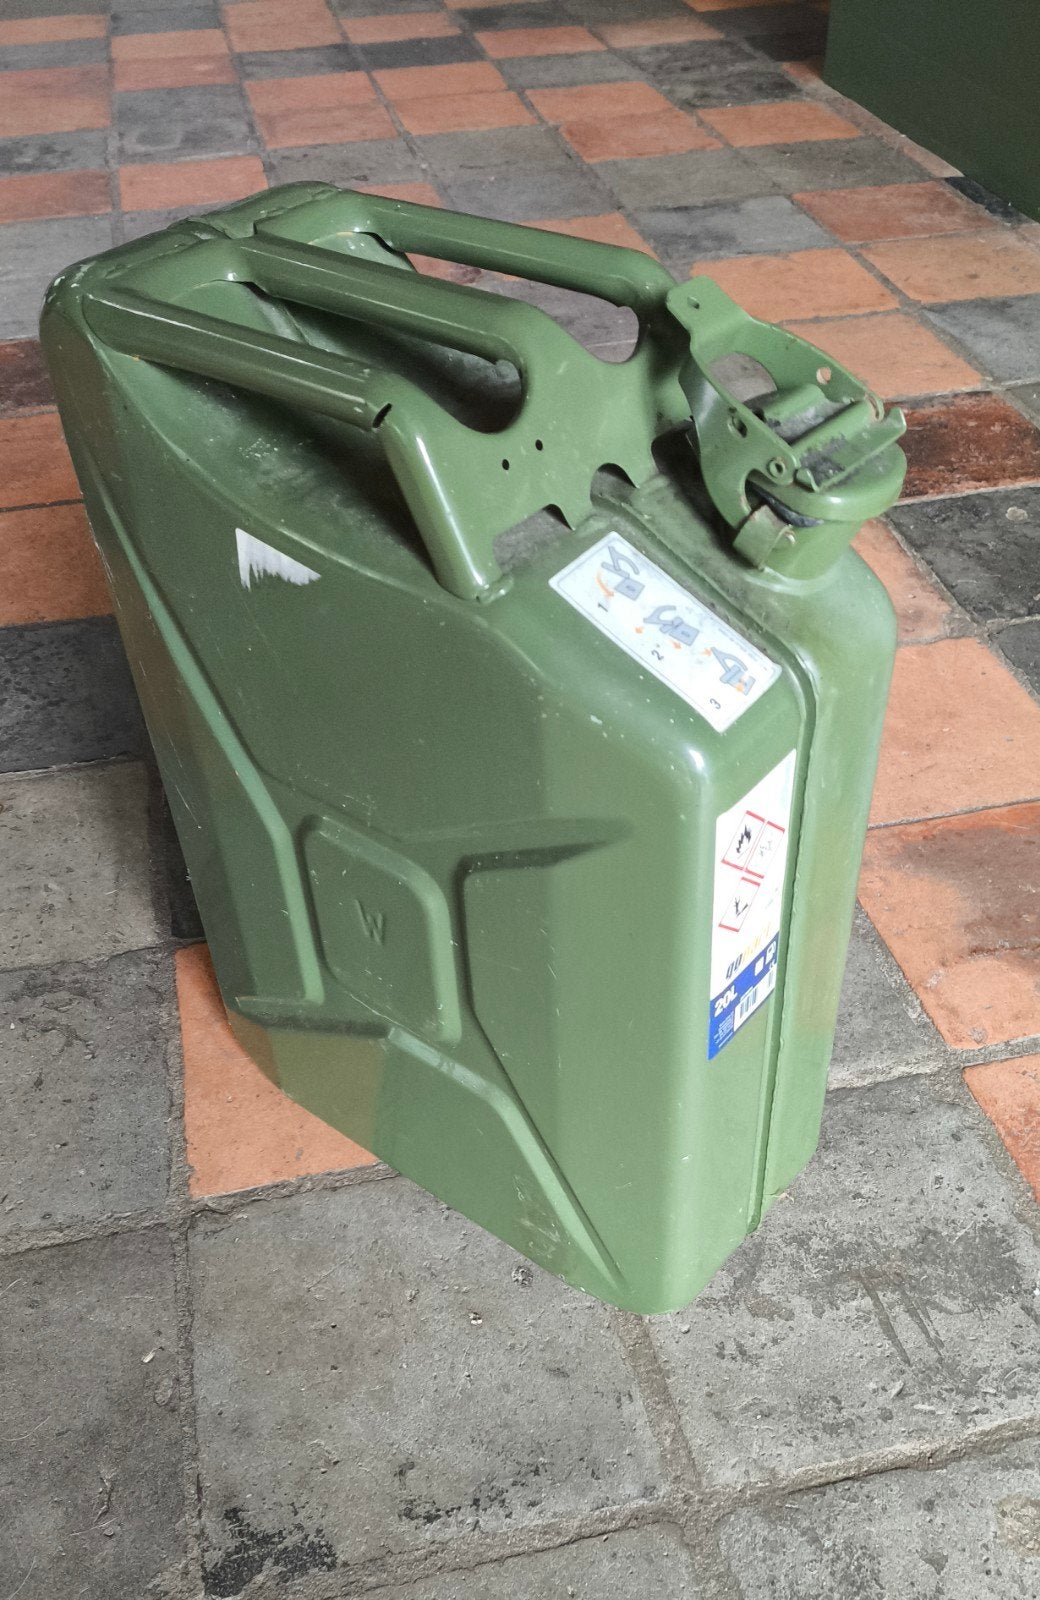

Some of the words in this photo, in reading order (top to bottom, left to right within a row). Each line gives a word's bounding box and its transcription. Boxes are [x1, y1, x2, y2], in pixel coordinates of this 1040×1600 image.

[597, 602, 609, 613] 1
[651, 649, 664, 661] 2
[709, 697, 722, 710] 3
[354, 898, 386, 946] W
[714, 985, 739, 1018] 20L
